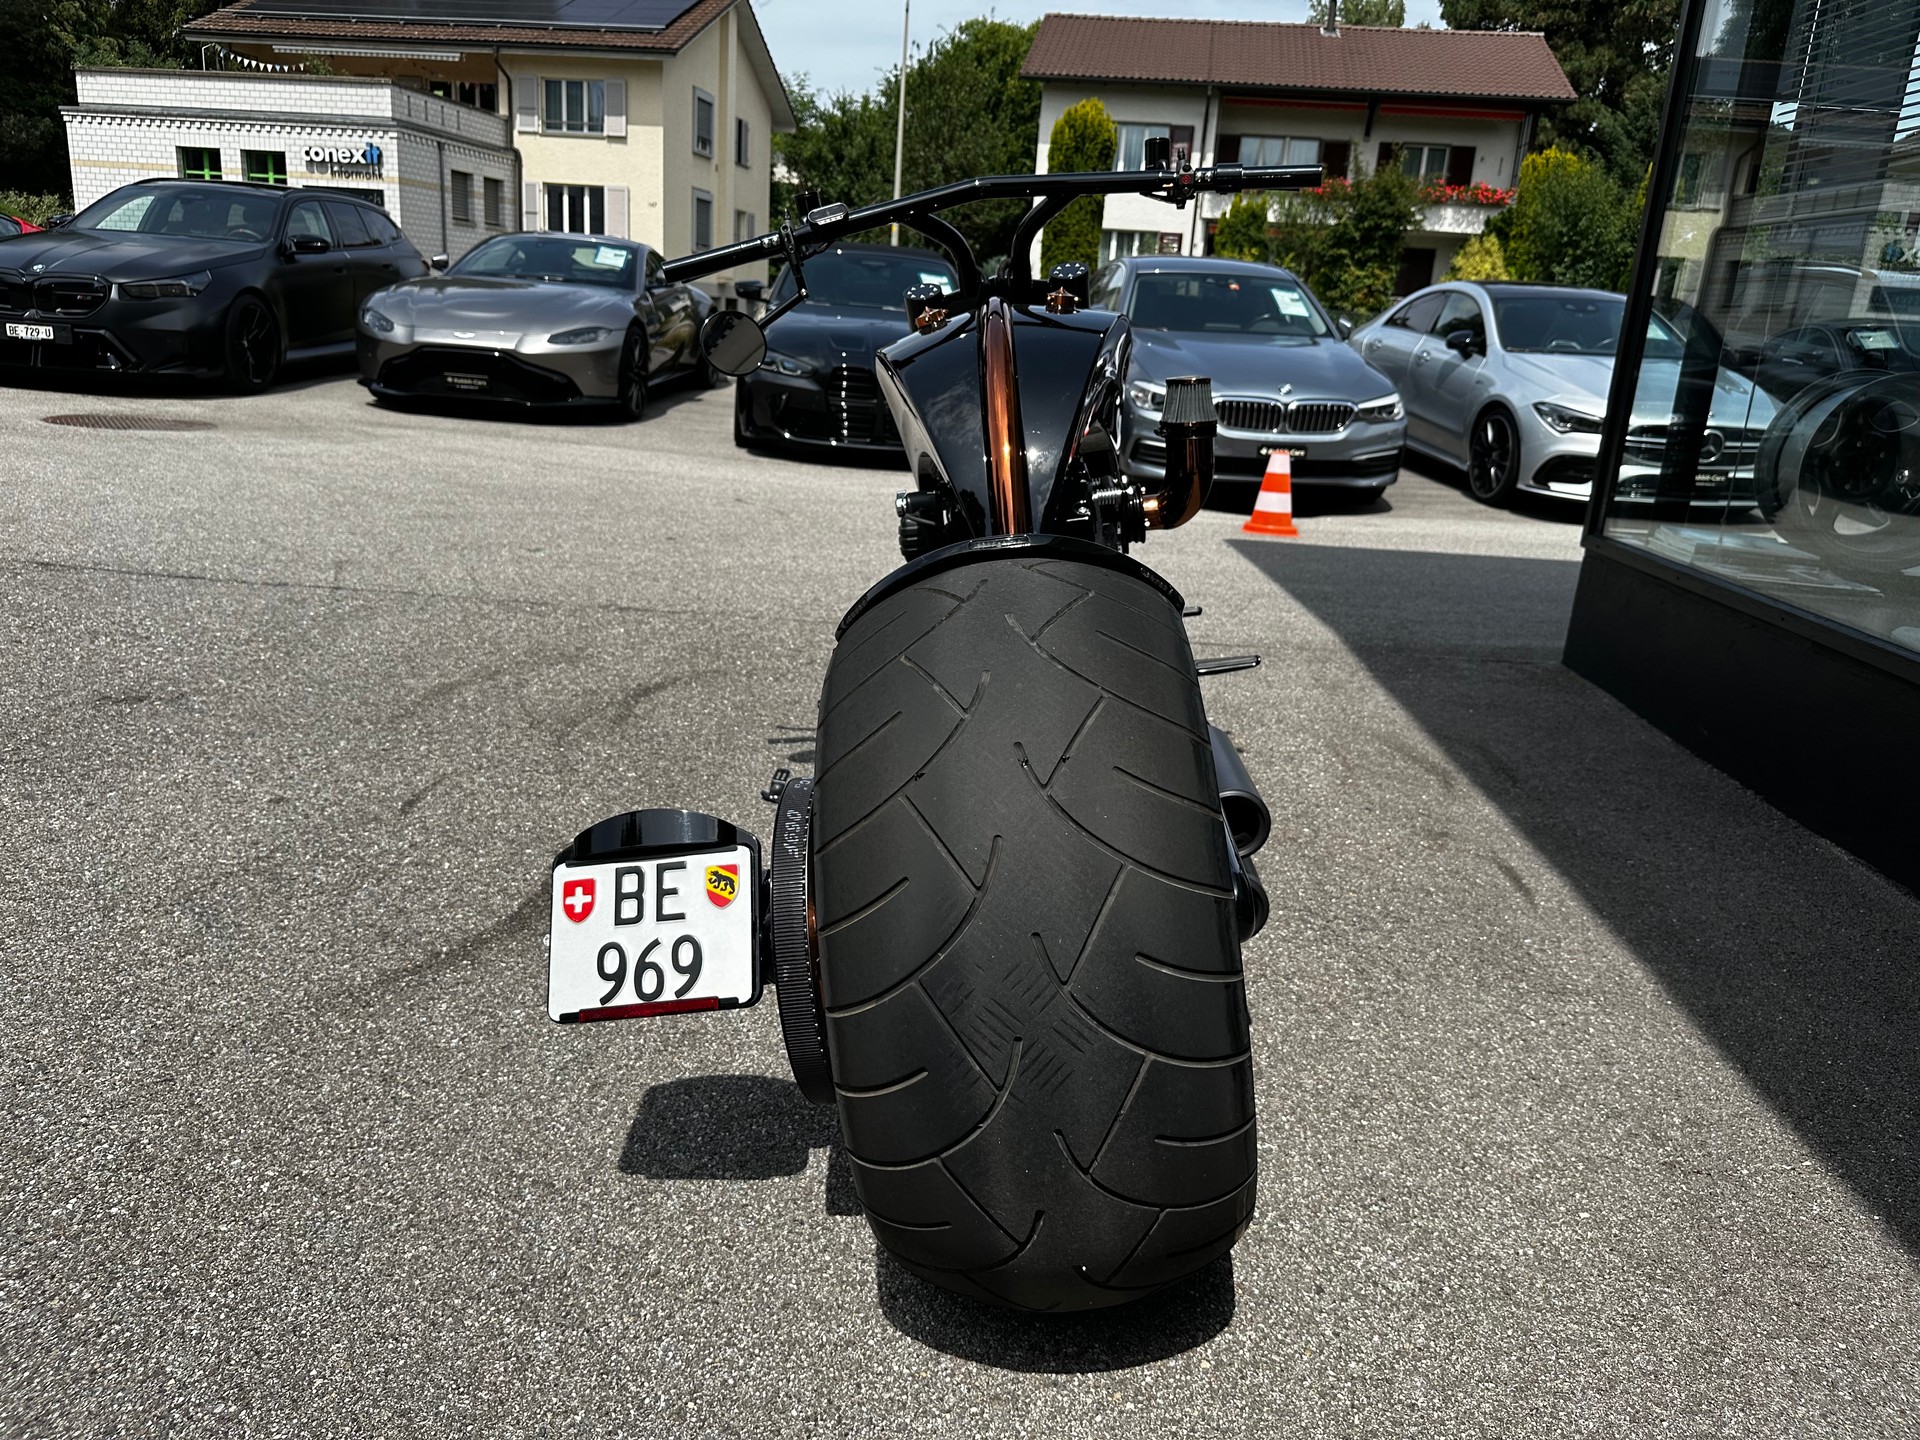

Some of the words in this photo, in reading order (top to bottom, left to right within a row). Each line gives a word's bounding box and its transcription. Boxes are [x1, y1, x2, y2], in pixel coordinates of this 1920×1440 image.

[301, 142, 380, 164] conexit
[614, 861, 687, 926] BE
[596, 934, 703, 1006] 969
